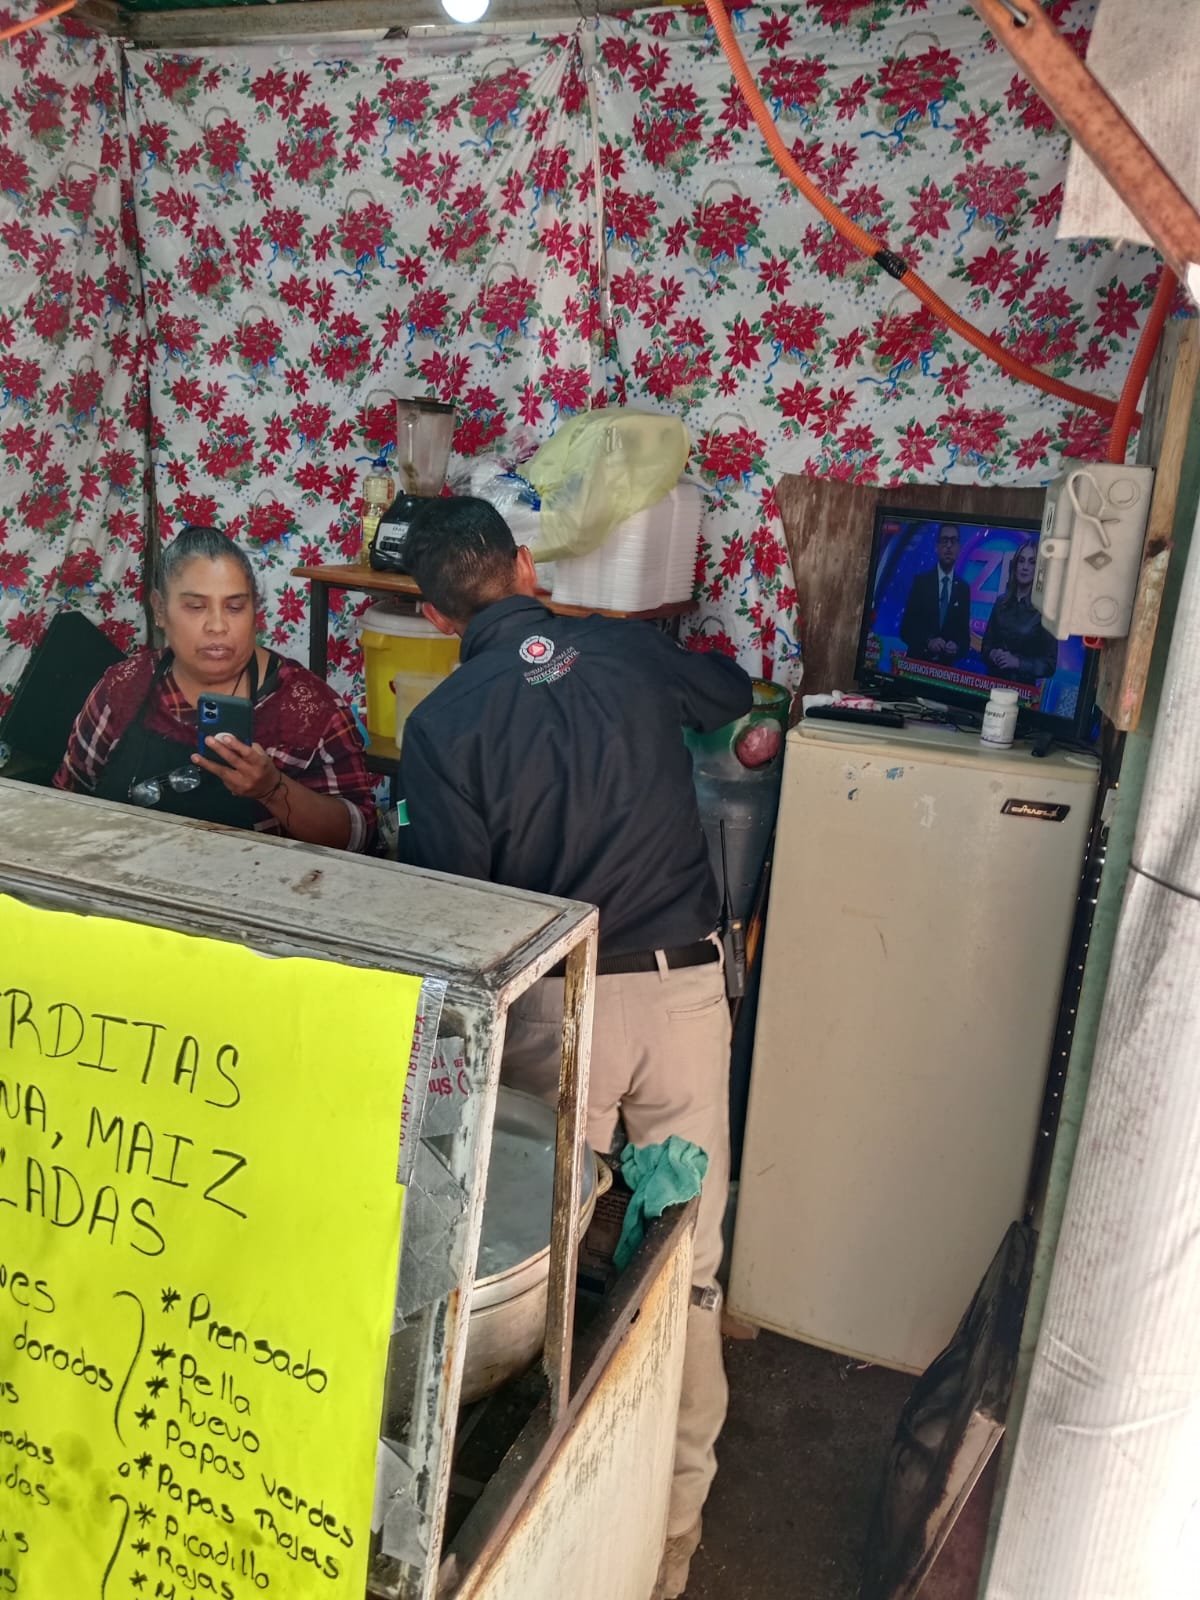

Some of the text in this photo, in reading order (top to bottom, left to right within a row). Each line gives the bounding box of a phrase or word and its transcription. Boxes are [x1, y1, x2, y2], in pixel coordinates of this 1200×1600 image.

[929, 667, 960, 683] PENDIENTES
[961, 674, 974, 687] ANTE
[0, 987, 241, 1109] RDITAS
[86, 1106, 247, 1220] MAIZ
[13, 1319, 114, 1393] dorados
